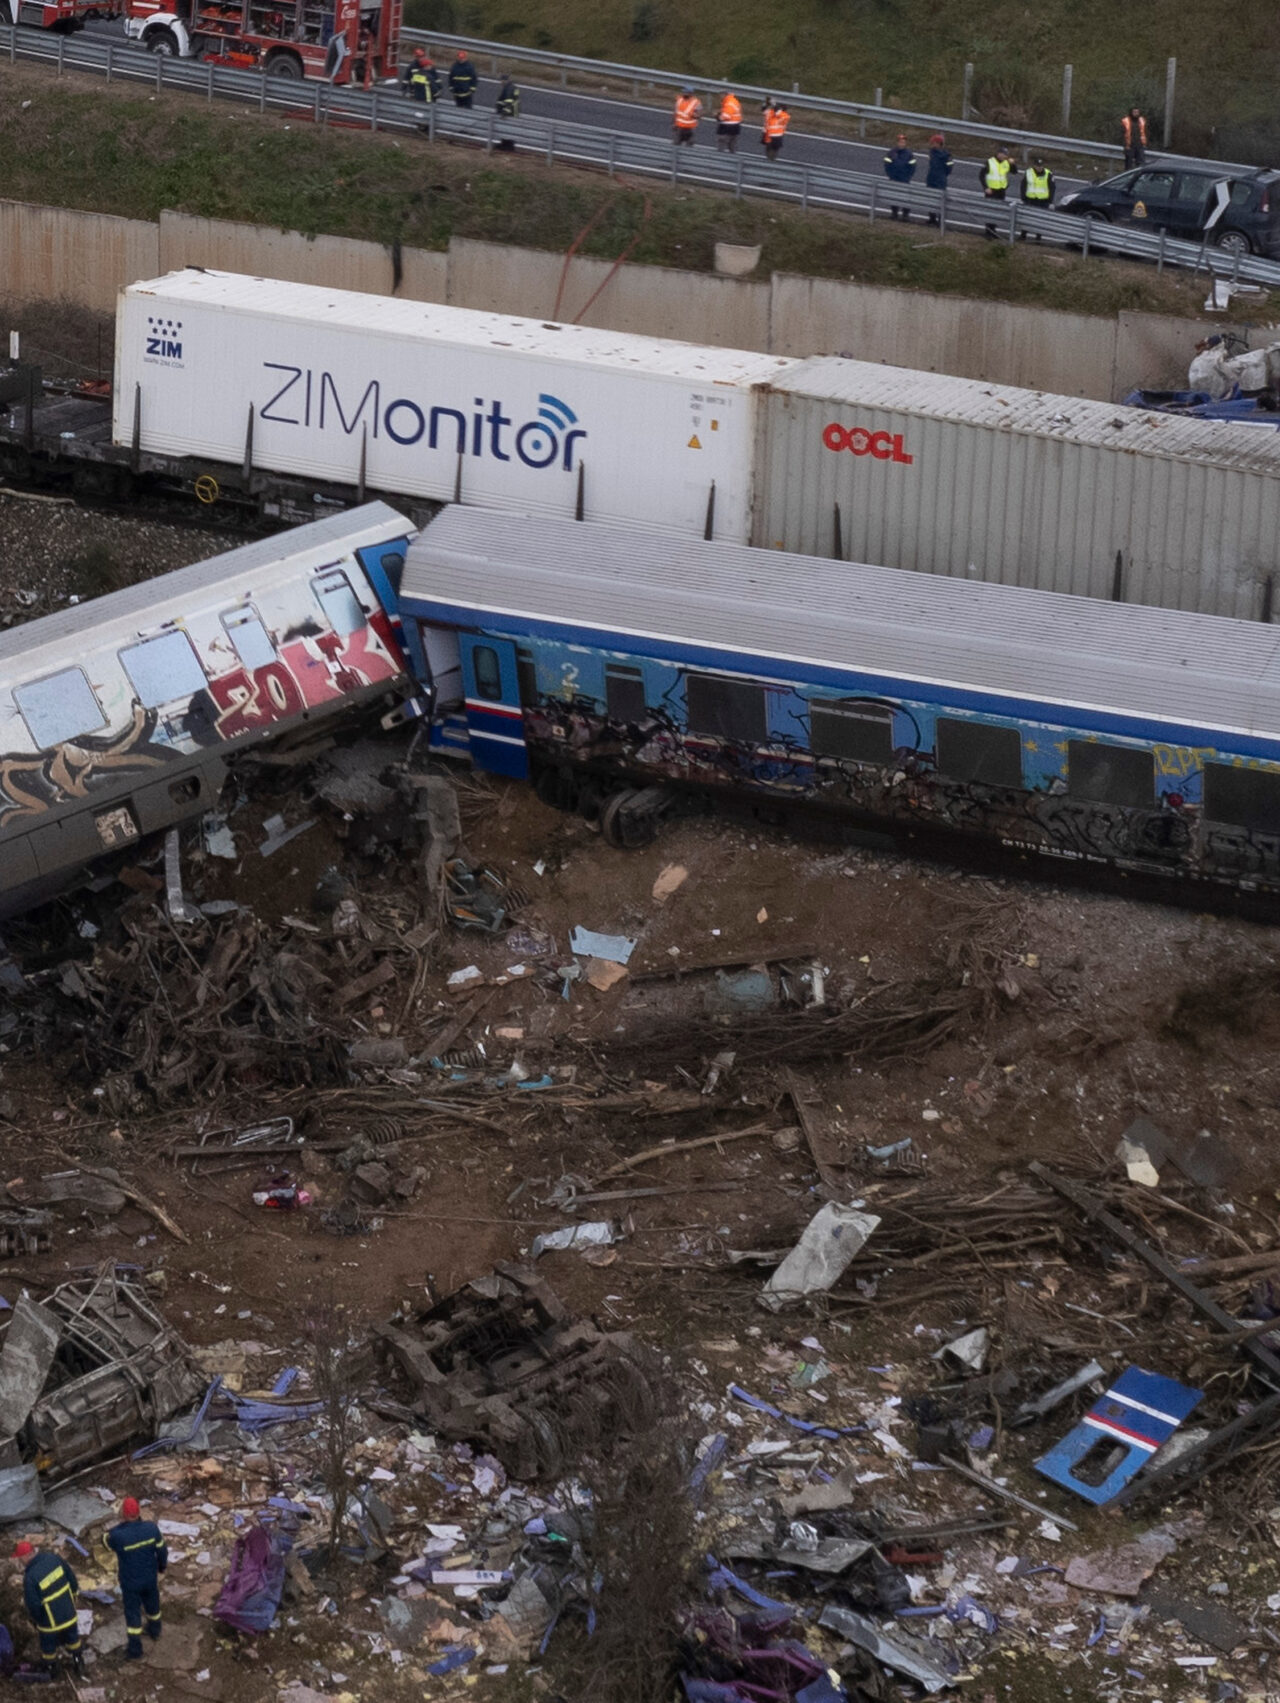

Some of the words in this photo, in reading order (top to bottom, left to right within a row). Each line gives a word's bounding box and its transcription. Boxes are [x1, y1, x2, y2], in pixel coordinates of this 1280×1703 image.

[147, 337, 182, 359] ZIM
[260, 362, 587, 472] ZIMonitor
[823, 423, 913, 465] OOCL
